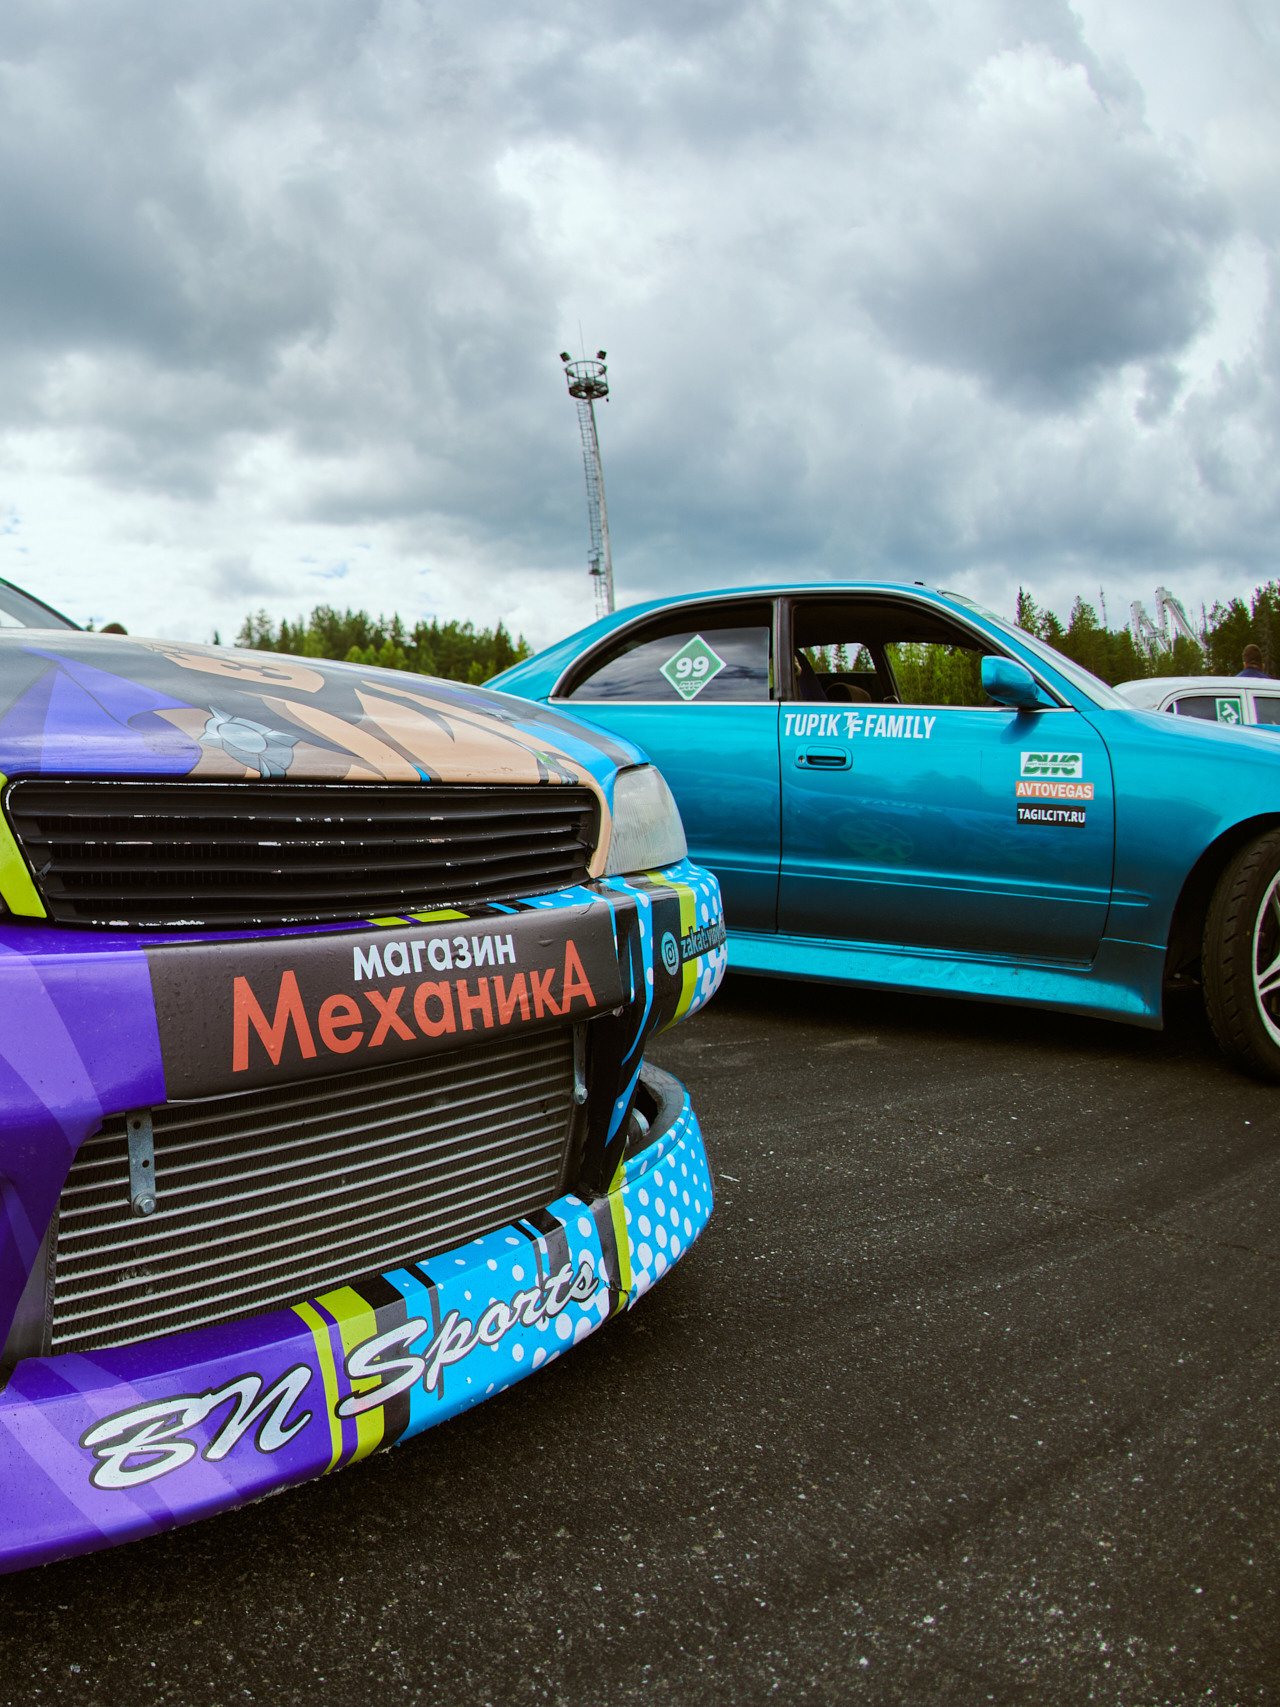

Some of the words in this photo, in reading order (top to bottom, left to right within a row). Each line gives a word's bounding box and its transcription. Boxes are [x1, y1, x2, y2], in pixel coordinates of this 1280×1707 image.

[675, 656, 709, 678] 99
[785, 713, 841, 737] TUPIK
[864, 714, 937, 739] FAMILY
[1022, 754, 1080, 775] DWC
[1017, 782, 1092, 798] AVTOVEGAS
[1017, 808, 1086, 823] TAGILCITY.RU
[353, 933, 517, 982] магазин
[232, 939, 598, 1073] МеханикА
[80, 1363, 313, 1490] BN
[335, 1261, 599, 1419] Sports
